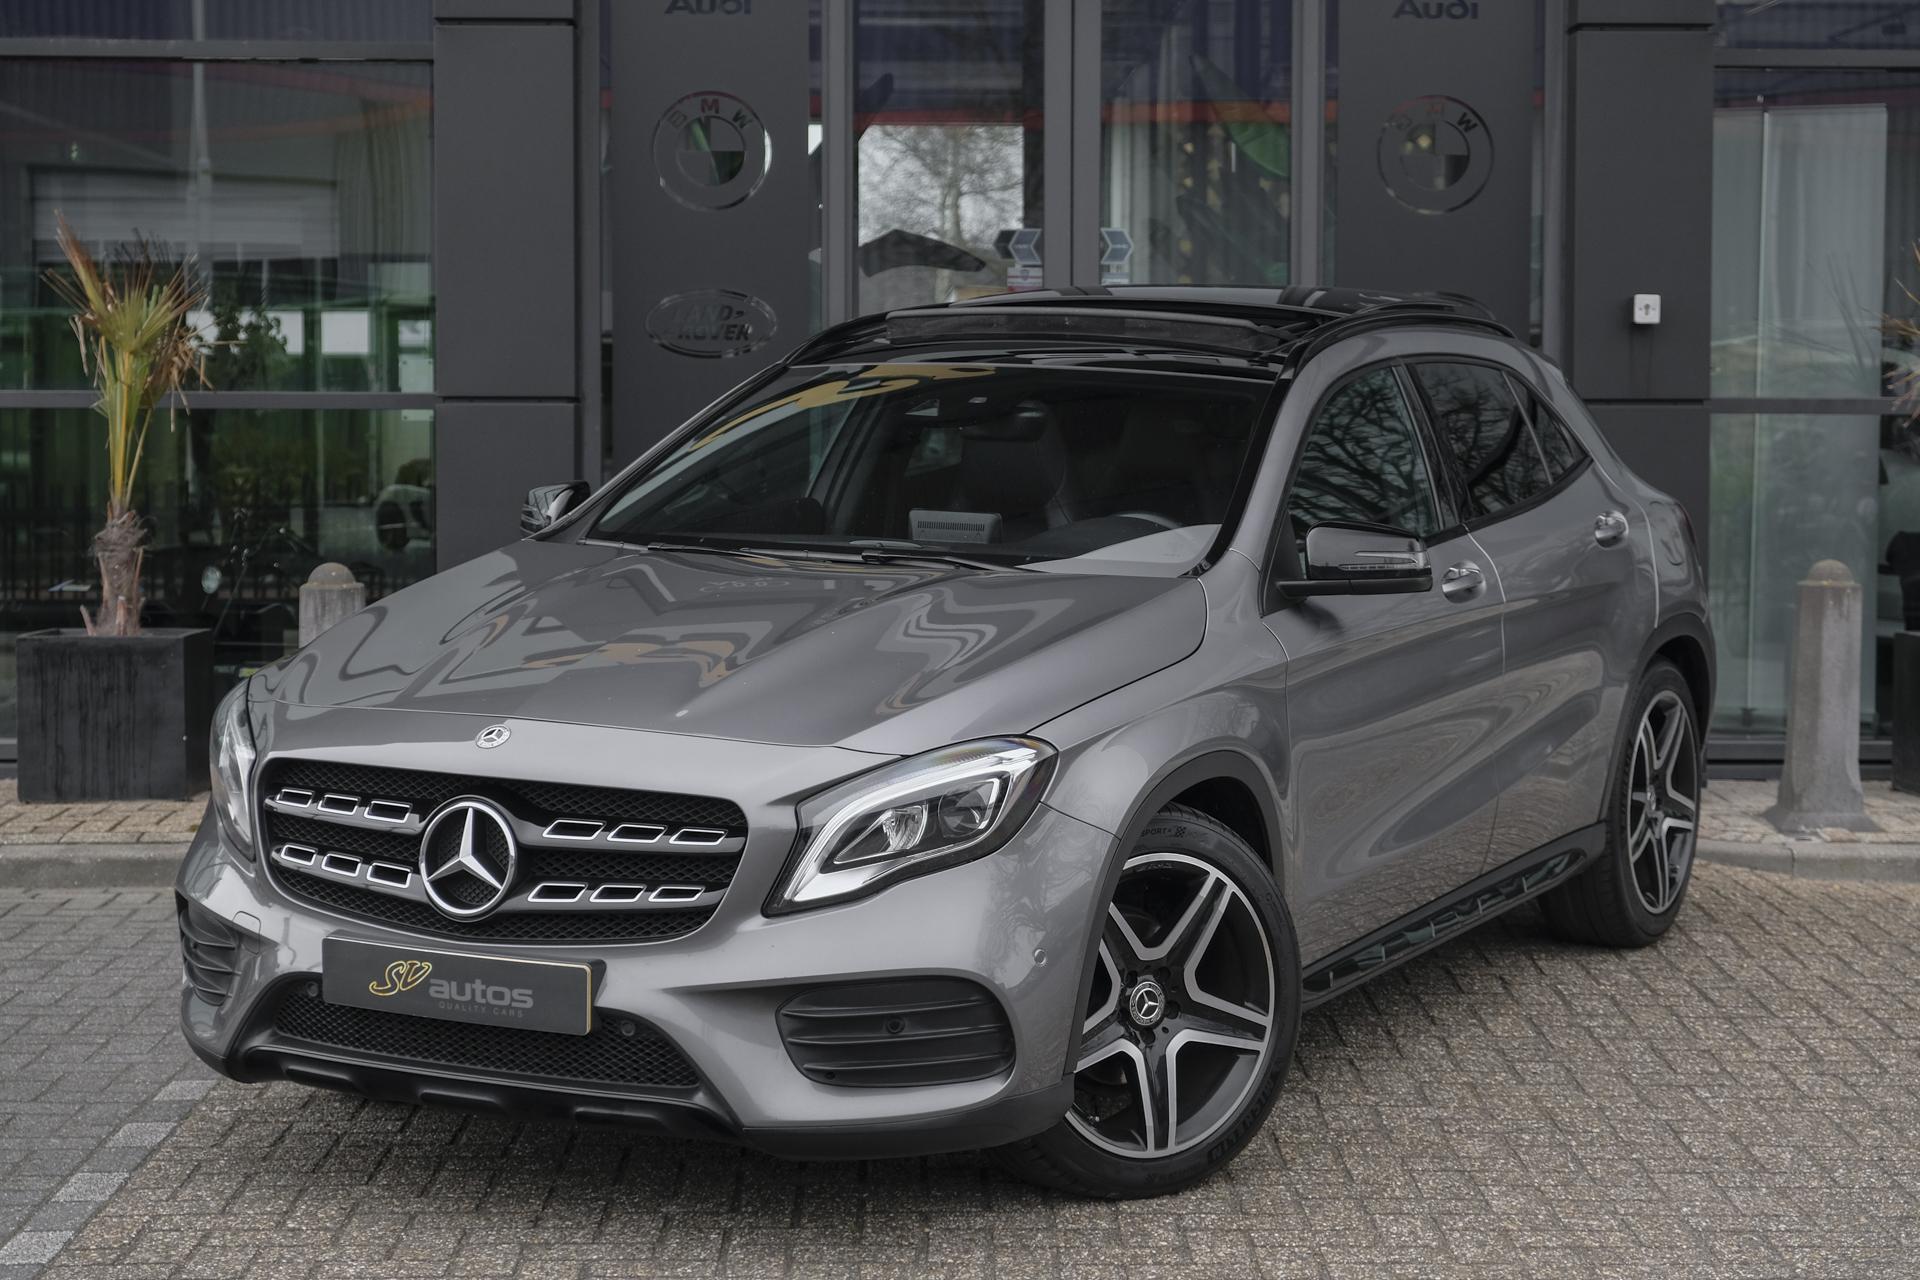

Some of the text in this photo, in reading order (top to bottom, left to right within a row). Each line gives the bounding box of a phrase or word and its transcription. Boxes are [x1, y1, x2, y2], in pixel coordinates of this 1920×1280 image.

[1392, 0, 1479, 19] Audi
[668, 98, 753, 129] BMW
[368, 959, 534, 1009] SV autos
[438, 1001, 524, 1018] QUALITY CARS
